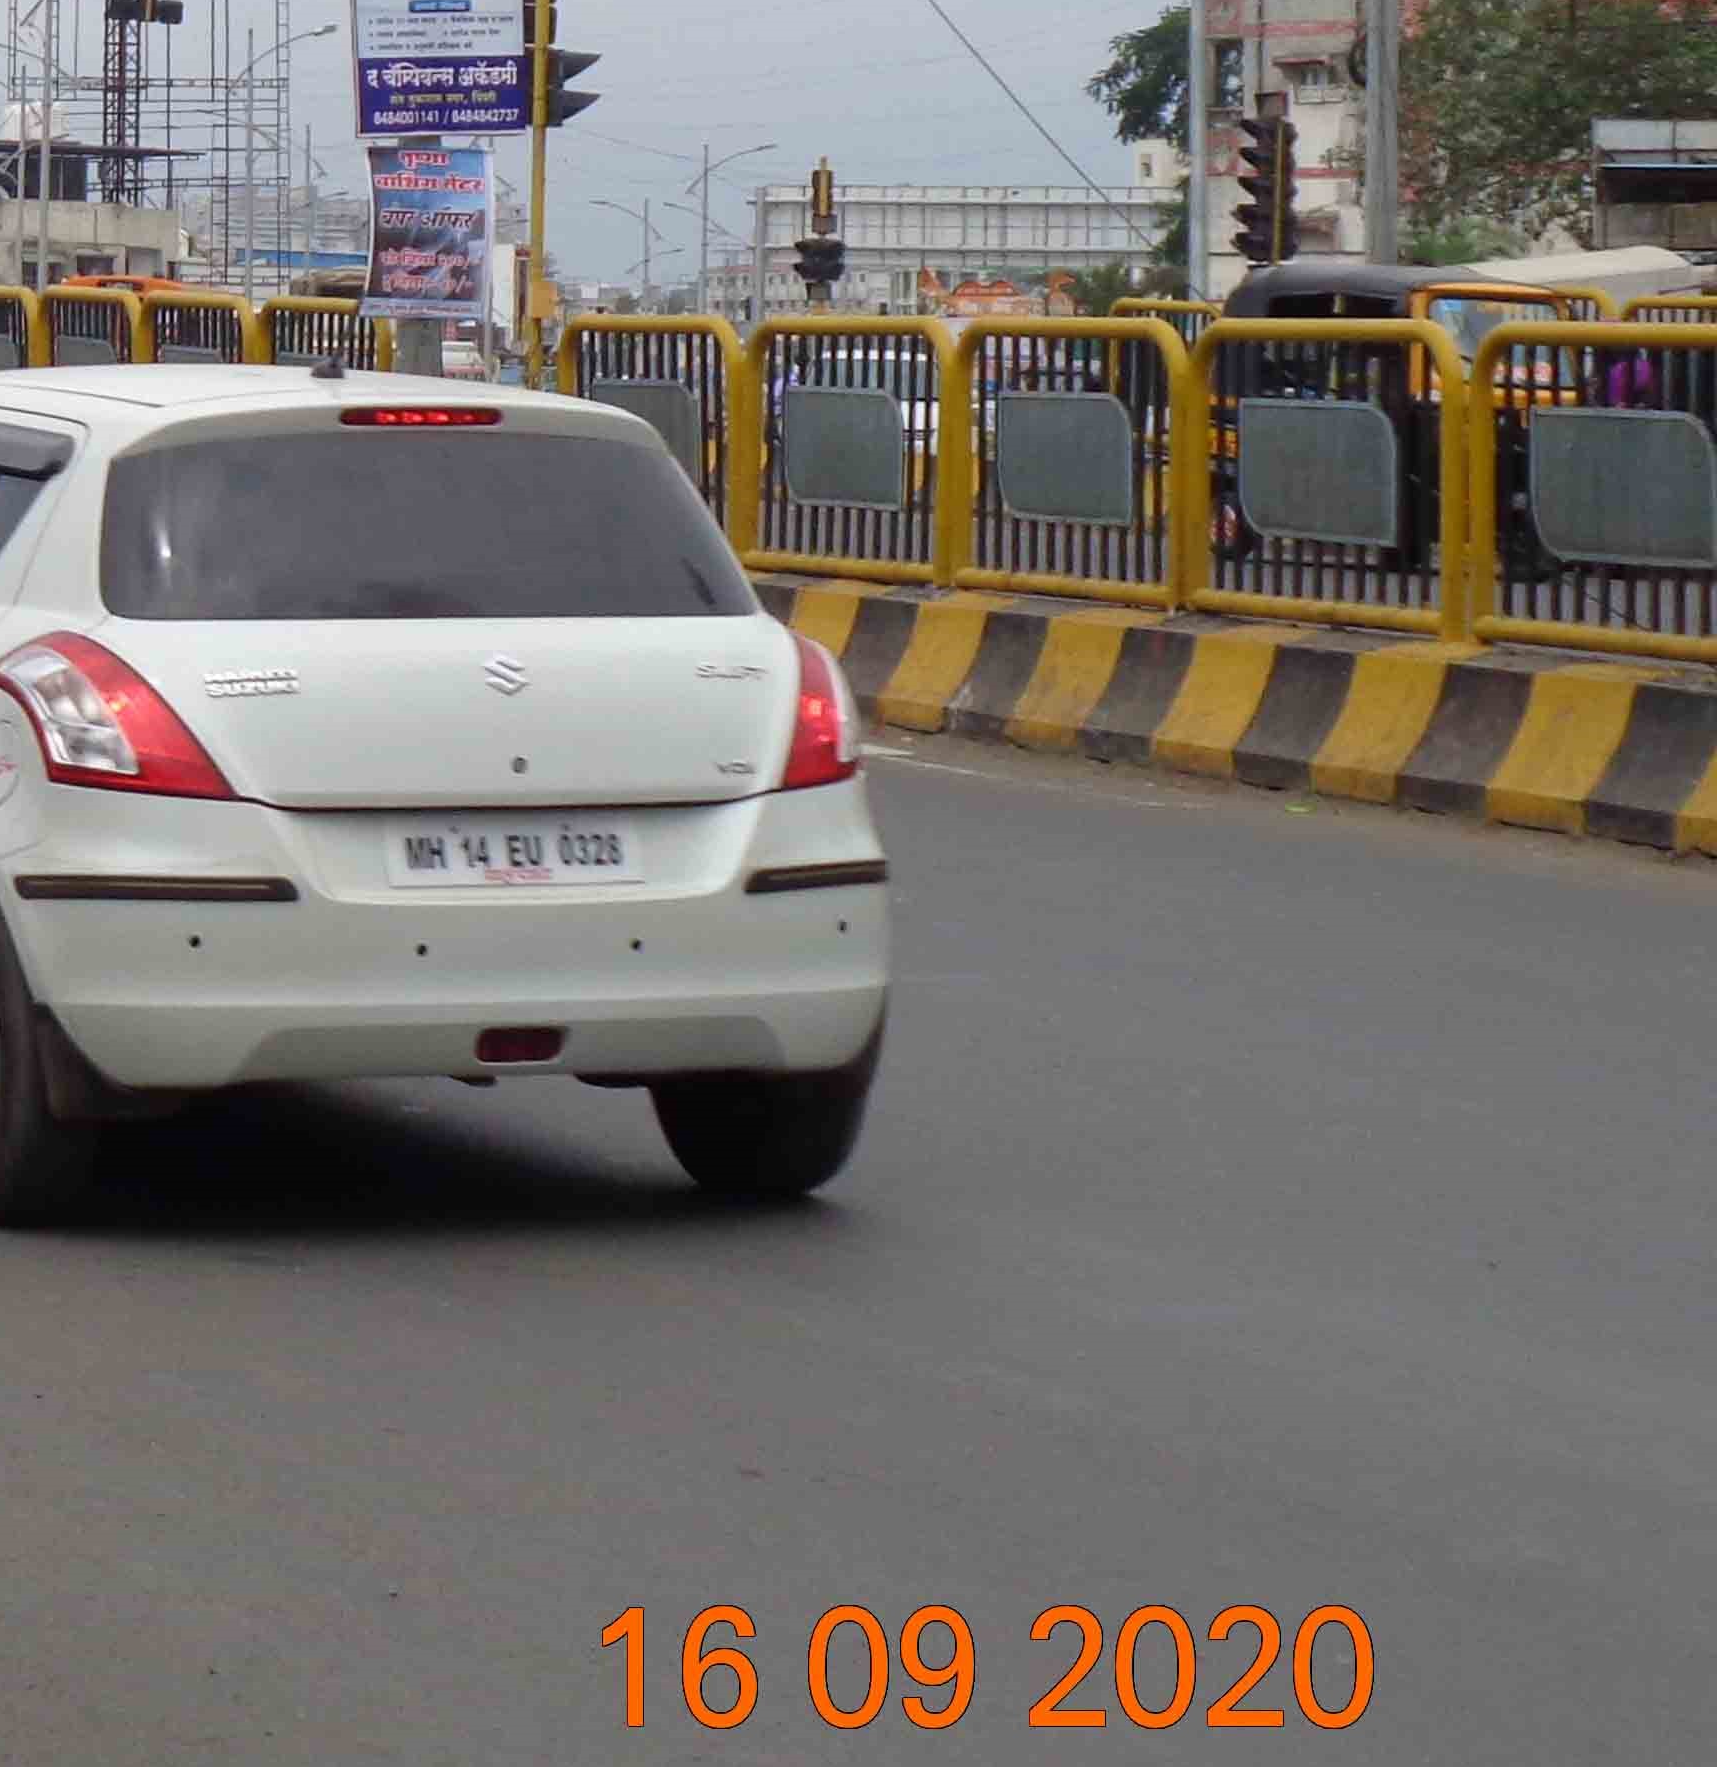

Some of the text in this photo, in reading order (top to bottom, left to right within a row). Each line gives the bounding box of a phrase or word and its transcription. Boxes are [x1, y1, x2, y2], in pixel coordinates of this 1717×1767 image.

[405, 832, 623, 869] MH 14 EU 0328
